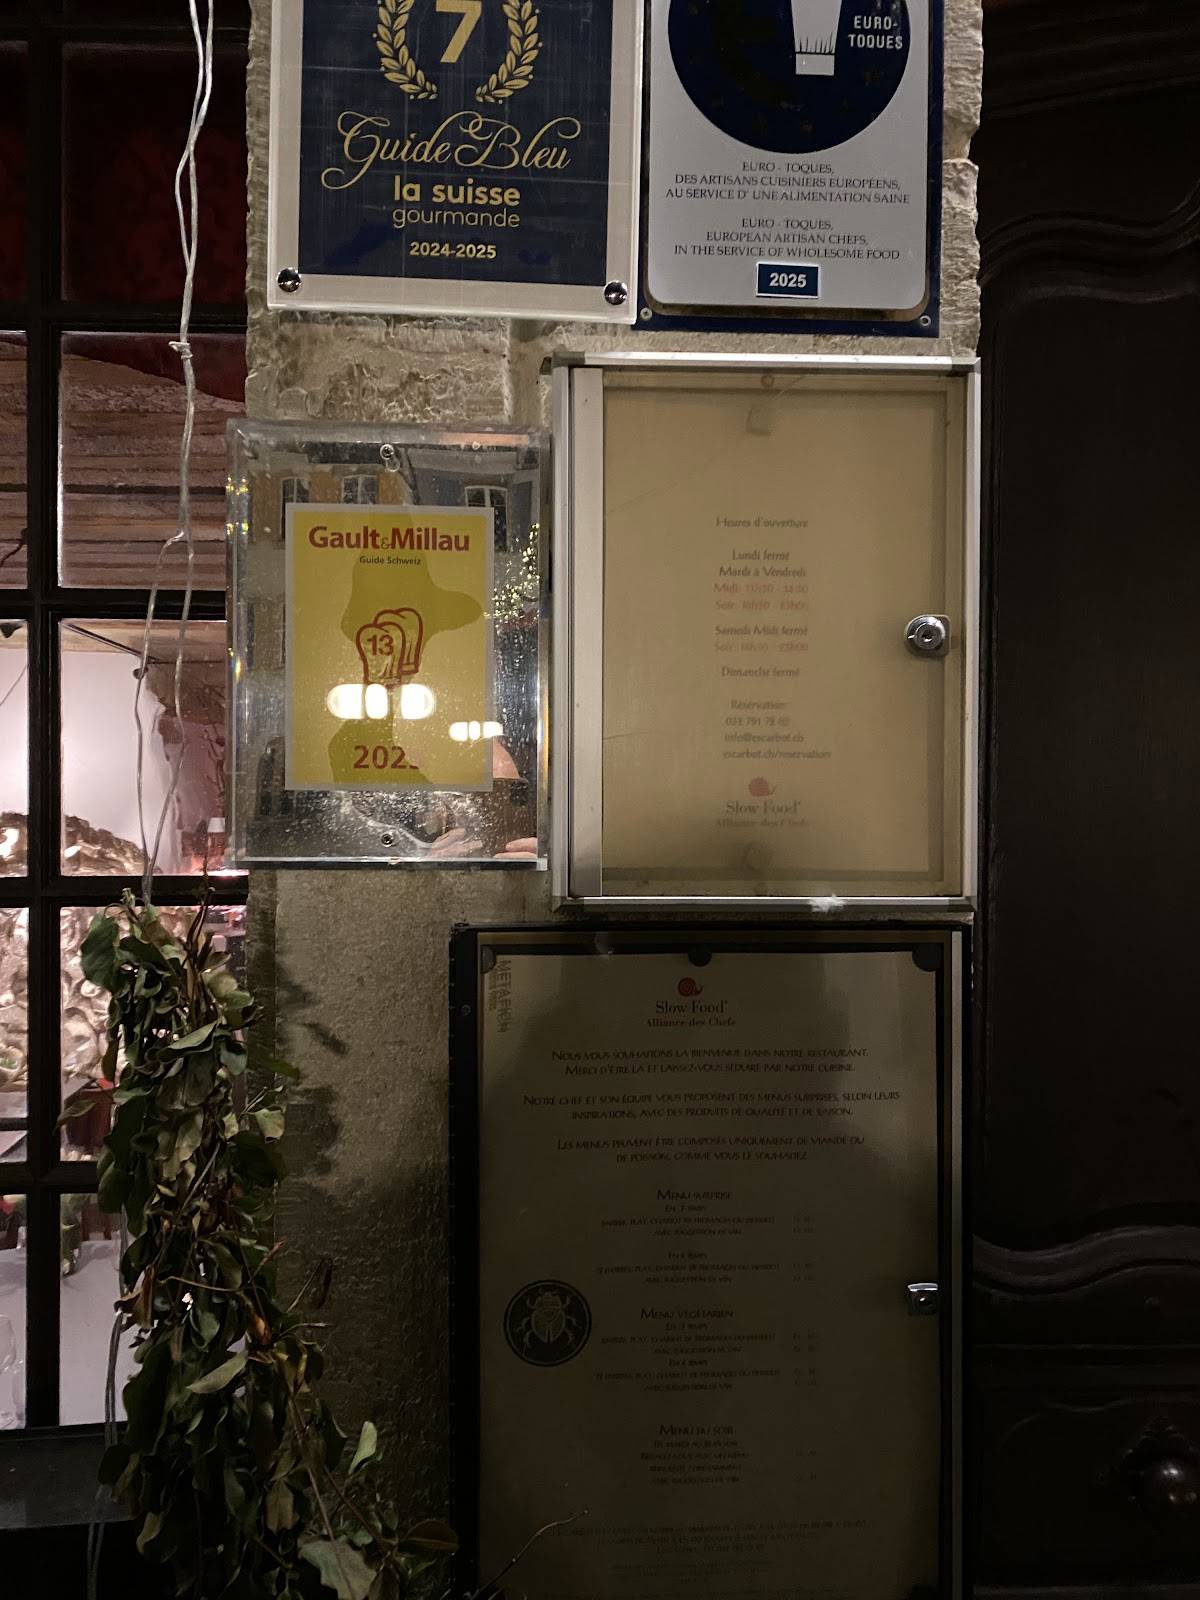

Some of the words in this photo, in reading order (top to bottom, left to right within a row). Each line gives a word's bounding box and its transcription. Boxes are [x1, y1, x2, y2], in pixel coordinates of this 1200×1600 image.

[853, 15, 898, 30] EURO-
[435, 0, 482, 63] 7
[848, 34, 903, 50] TOQUES
[321, 110, 478, 190] Guide
[454, 116, 582, 170] Bleu
[742, 161, 776, 173] EURO
[675, 174, 698, 185] DES
[700, 174, 759, 186] ARTISANS
[760, 176, 826, 188] CUISINIERS
[393, 175, 421, 201] la
[431, 178, 521, 206] suisse
[666, 188, 684, 199] AU
[686, 188, 734, 199] SERVICE
[752, 190, 779, 201] UNE
[780, 190, 871, 203] ALIMENTATION
[874, 192, 910, 204] SAINE
[392, 207, 521, 229] gourmande
[742, 218, 775, 229] EURO
[706, 231, 772, 244] EUROPEAN
[774, 233, 826, 245] ARTISAN
[409, 242, 497, 259] 2024-2025
[674, 245, 688, 255] IN
[691, 245, 717, 256] THE
[717, 246, 766, 257] SERVICE
[768, 247, 783, 257] OF
[785, 247, 864, 259] WHOLESOME
[866, 249, 900, 260] FOOD
[768, 272, 807, 287] 2025
[359, 556, 385, 565] Guide
[386, 556, 422, 566] Schweiz
[366, 634, 394, 656] 13
[353, 745, 419, 770] 202
[726, 800, 760, 815] Slow
[655, 999, 688, 1014] Slow
